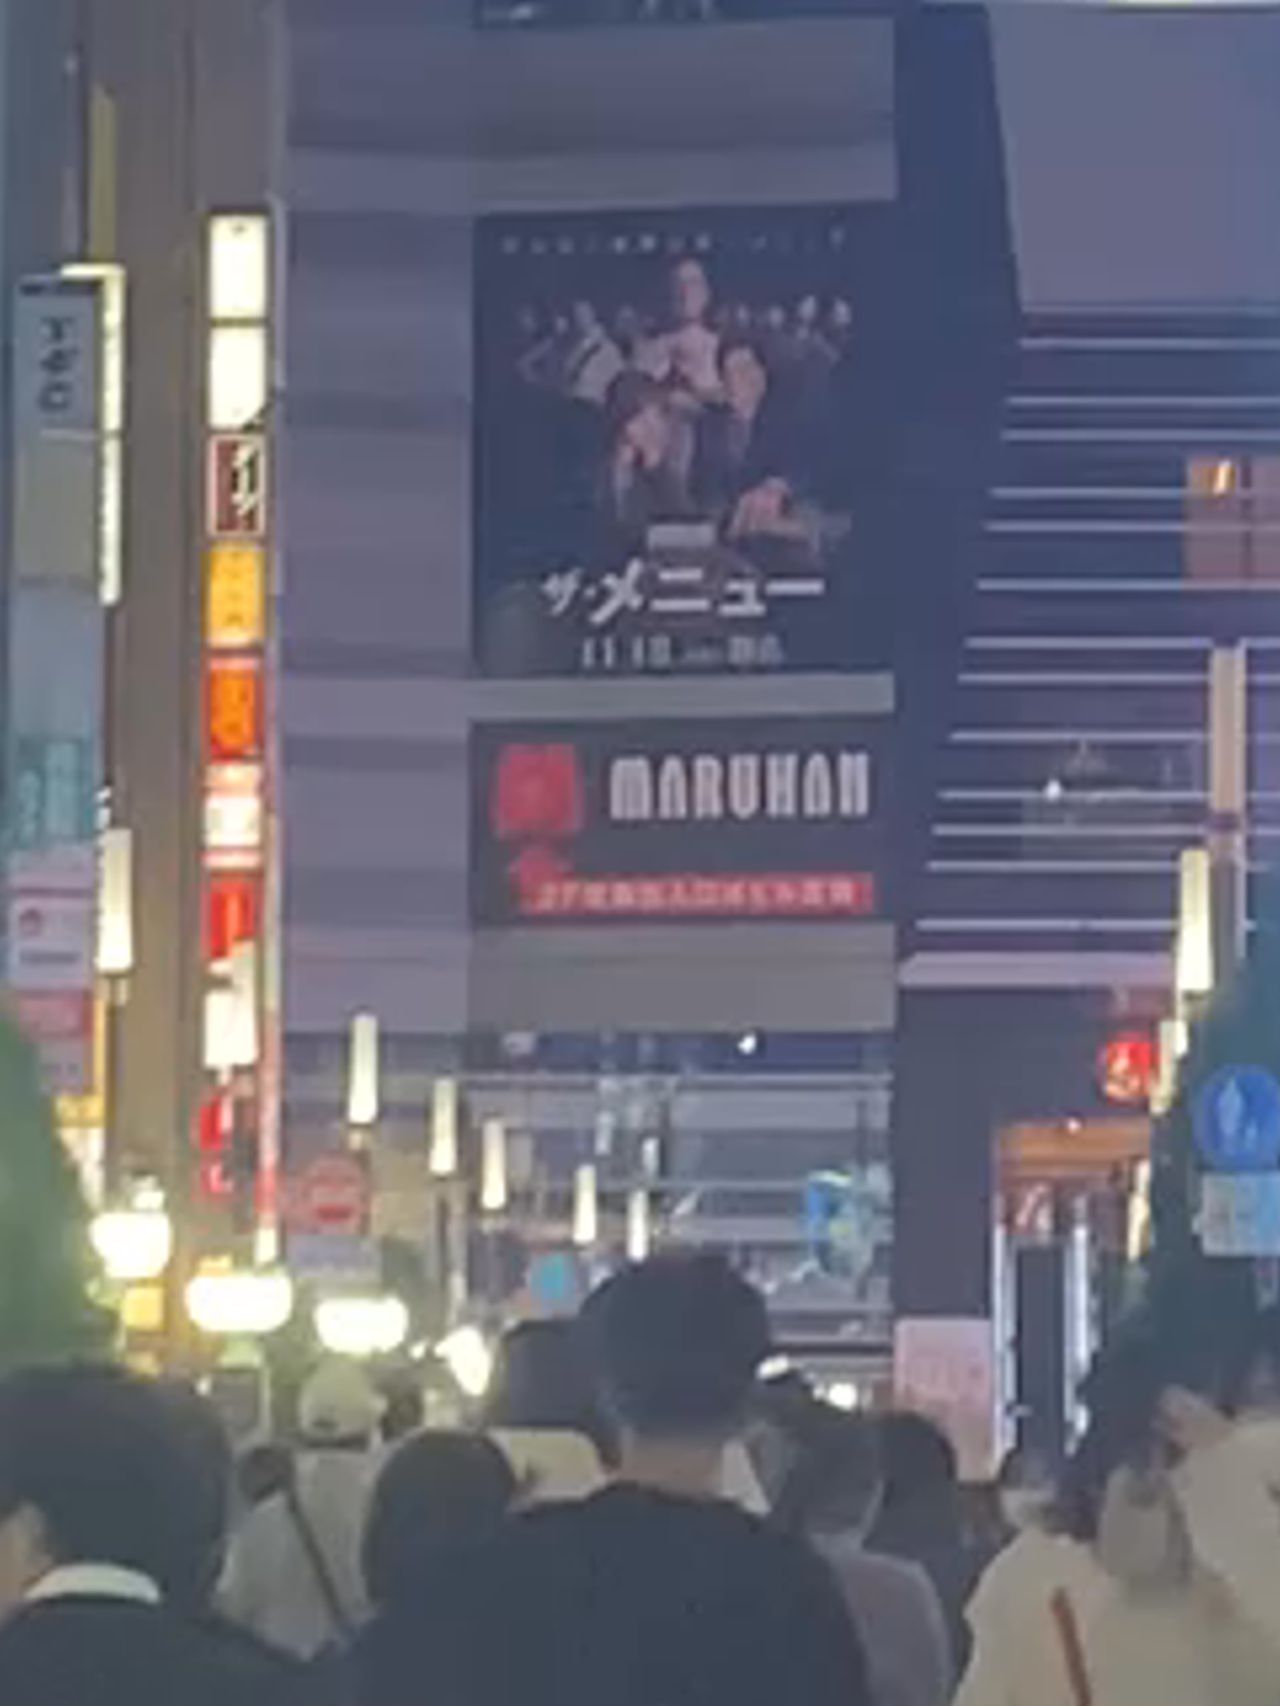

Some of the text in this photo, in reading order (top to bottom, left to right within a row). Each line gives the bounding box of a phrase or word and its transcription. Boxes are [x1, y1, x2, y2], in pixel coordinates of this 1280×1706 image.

[541, 558, 825, 627] ザ・メニュー
[608, 752, 871, 820] MARUHAN
